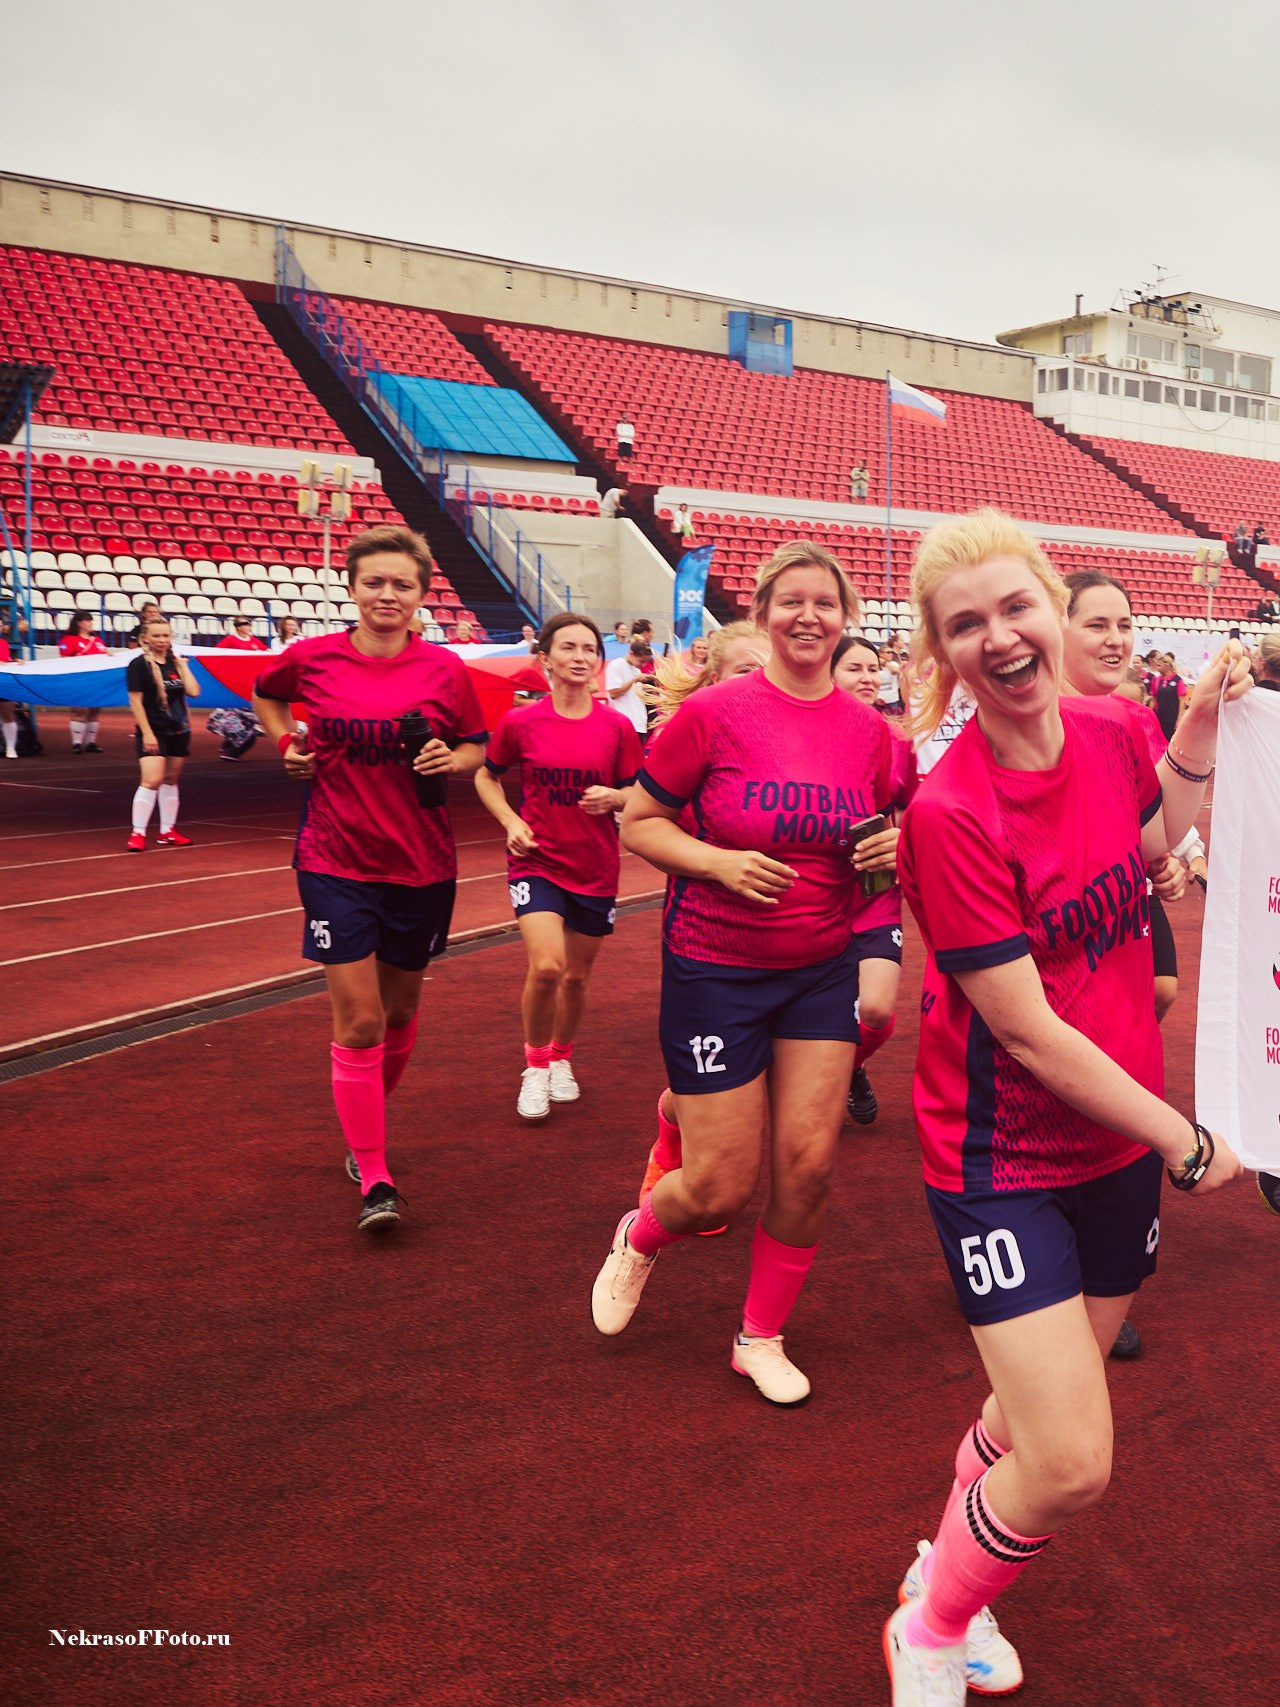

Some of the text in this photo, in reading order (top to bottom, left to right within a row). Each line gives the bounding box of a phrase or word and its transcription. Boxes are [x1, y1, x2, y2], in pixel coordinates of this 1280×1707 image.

[321, 717, 401, 744] FOOTB
[742, 781, 871, 818] FOOTBALL
[689, 1035, 727, 1074] 12
[960, 1228, 1026, 1296] 50
